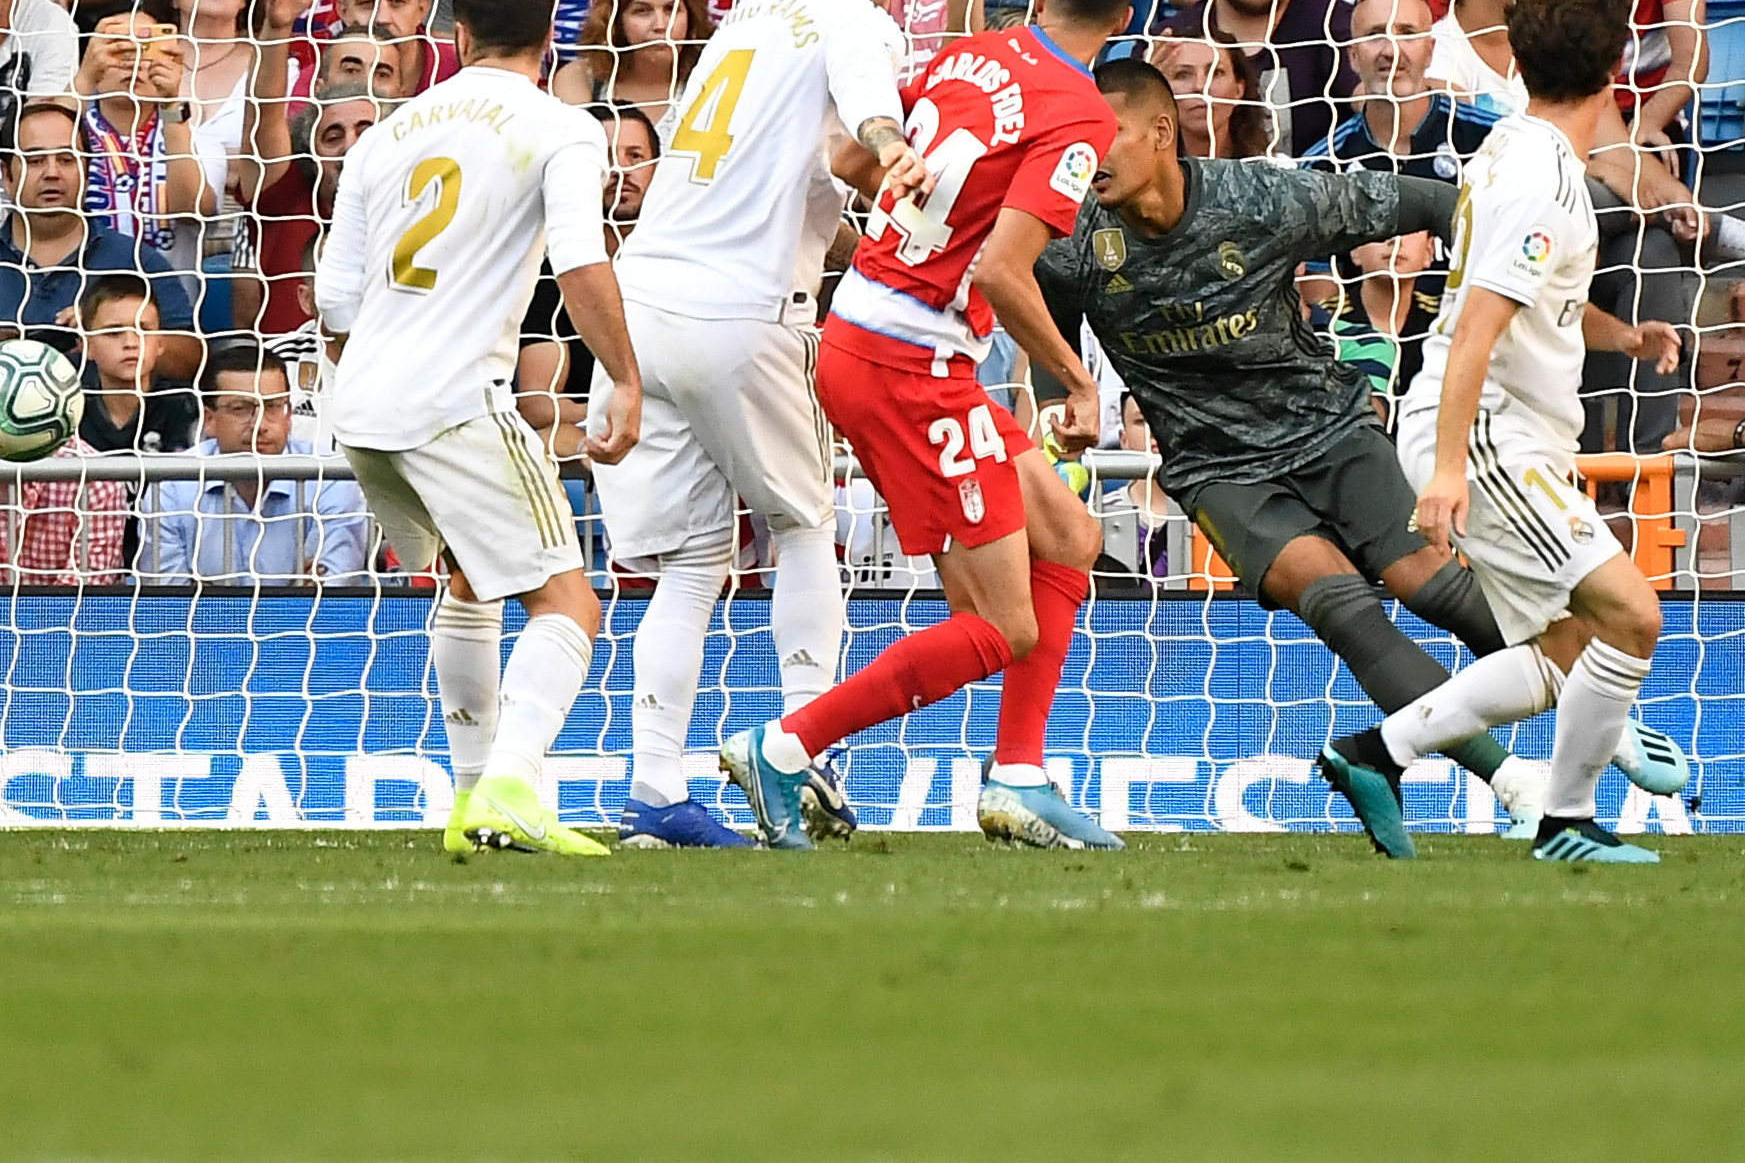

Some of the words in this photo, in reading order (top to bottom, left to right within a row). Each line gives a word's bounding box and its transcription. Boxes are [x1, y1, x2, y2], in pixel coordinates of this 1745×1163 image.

[392, 97, 515, 142] CARVAJAL
[661, 47, 757, 187] 4
[926, 51, 1011, 94] CARLOS
[990, 82, 1025, 147] FDEZ
[385, 155, 463, 296] 2
[1119, 307, 1259, 354] Emirates
[927, 403, 1008, 478] 24
